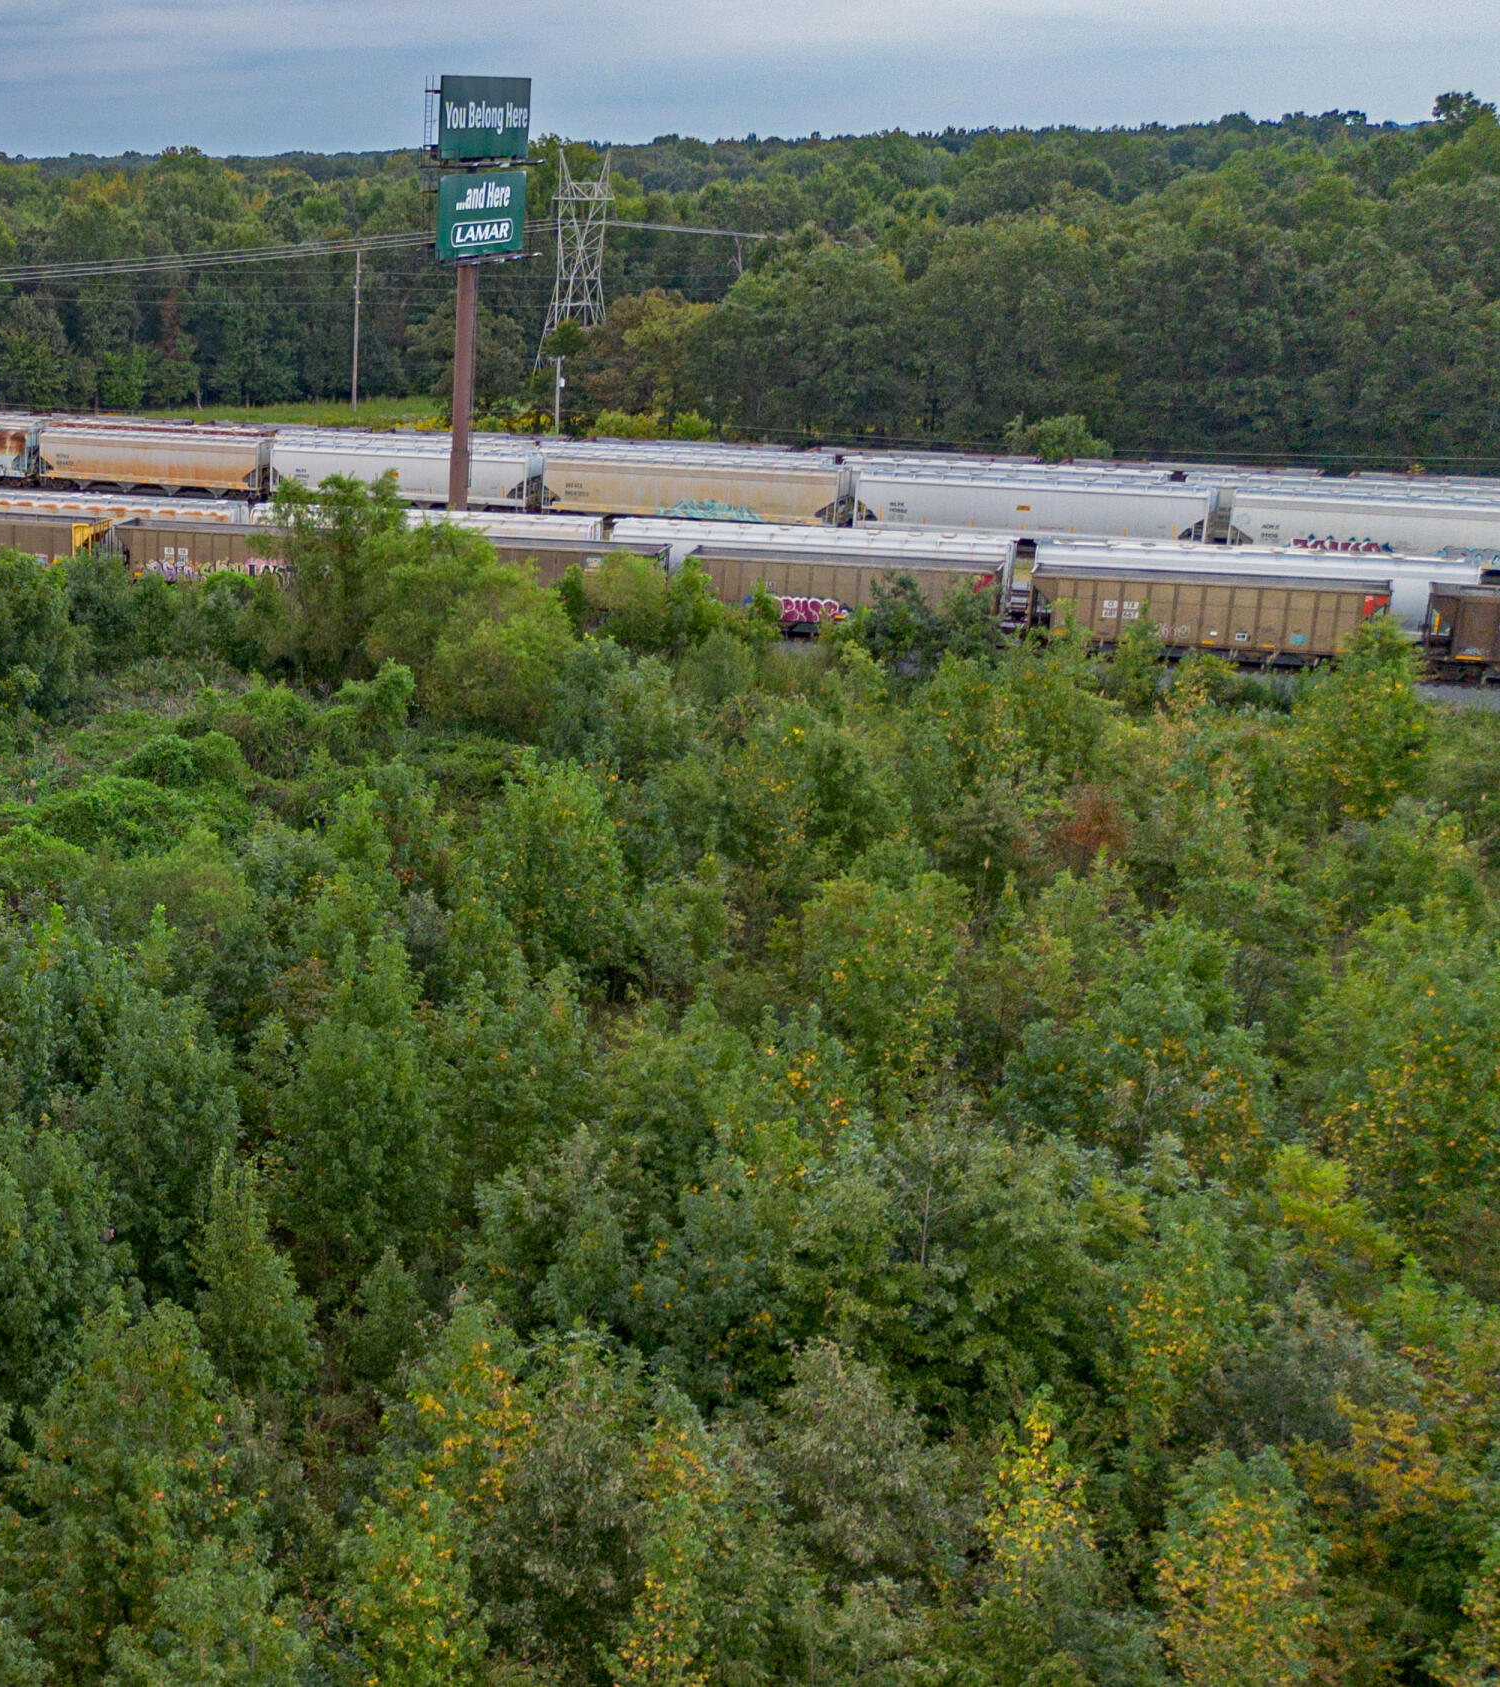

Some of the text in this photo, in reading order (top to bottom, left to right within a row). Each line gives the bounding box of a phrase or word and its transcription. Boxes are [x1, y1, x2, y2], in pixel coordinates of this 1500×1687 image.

[445, 100, 528, 135] You Belong Here
[486, 181, 511, 209] Here
[455, 222, 510, 243] LAMAR
